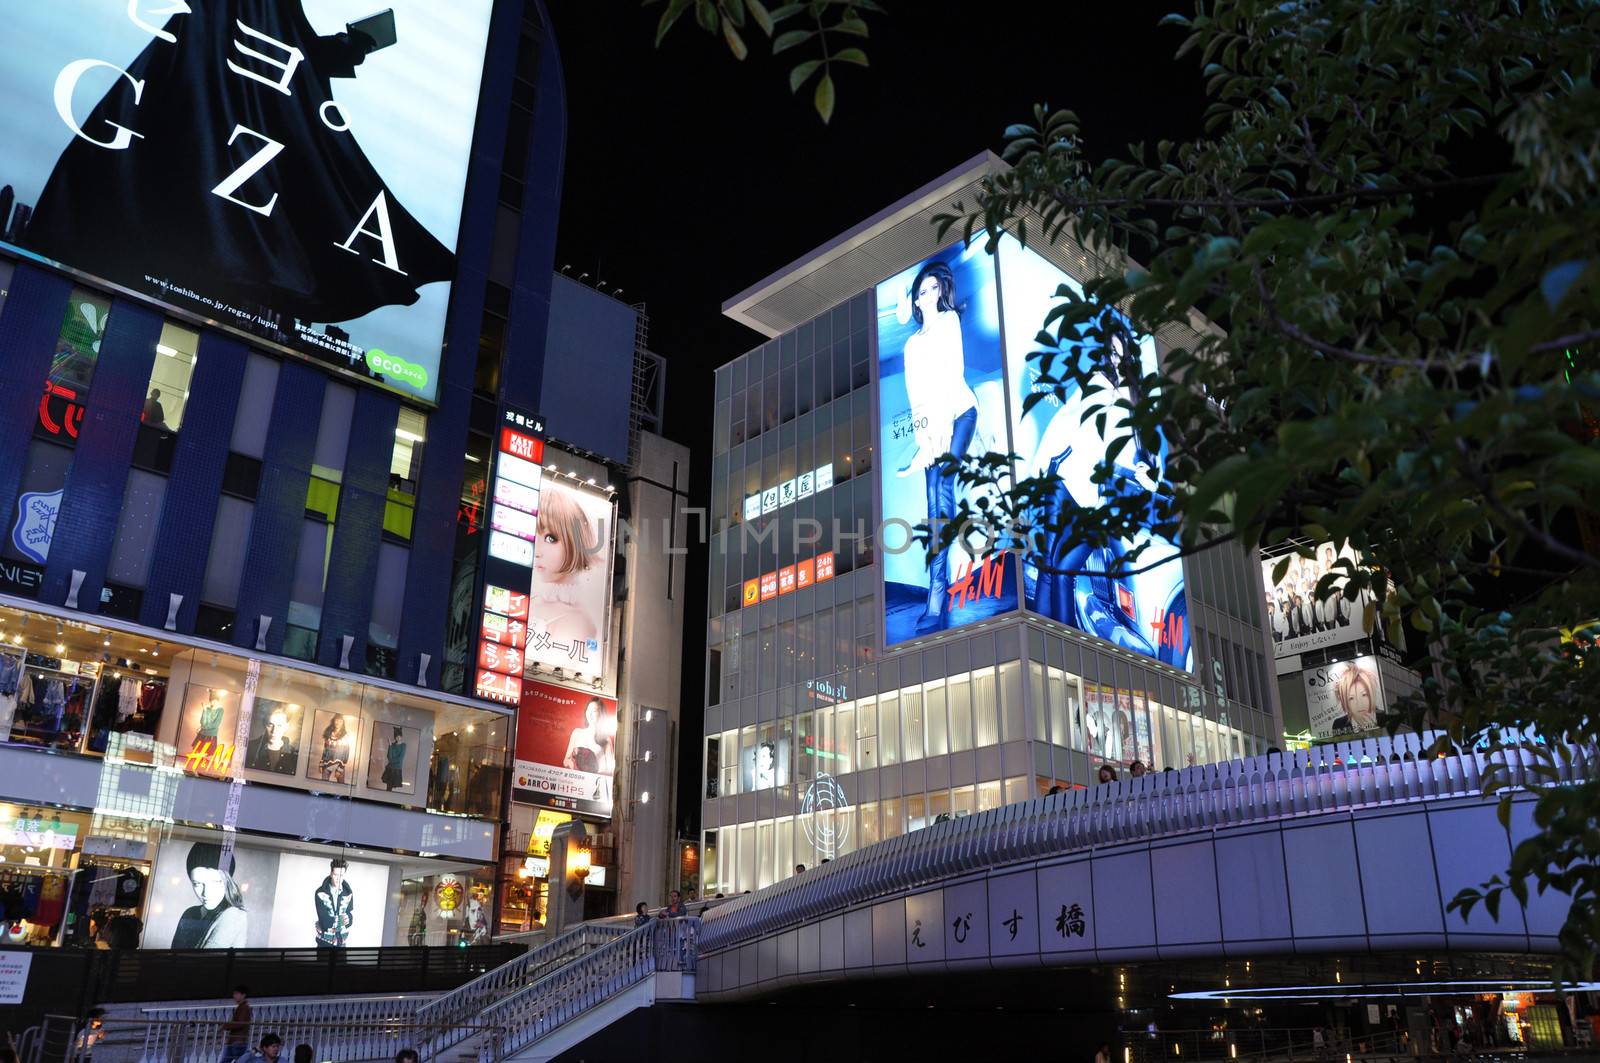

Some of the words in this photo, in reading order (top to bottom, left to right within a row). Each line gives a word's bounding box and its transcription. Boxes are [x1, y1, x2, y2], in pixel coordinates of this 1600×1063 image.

[144, 274, 279, 331] www.toshiba.co.jp/regza/lupin
[372, 355, 402, 375] eco
[817, 557, 832, 568] 24h
[946, 549, 1008, 612] H&M
[503, 594, 526, 695] インターネット
[1150, 606, 1184, 656] H&M
[480, 628, 501, 686] コミック
[184, 739, 236, 775] H&M
[527, 778, 557, 791] ARROW
[911, 903, 1087, 948] えびす橋
